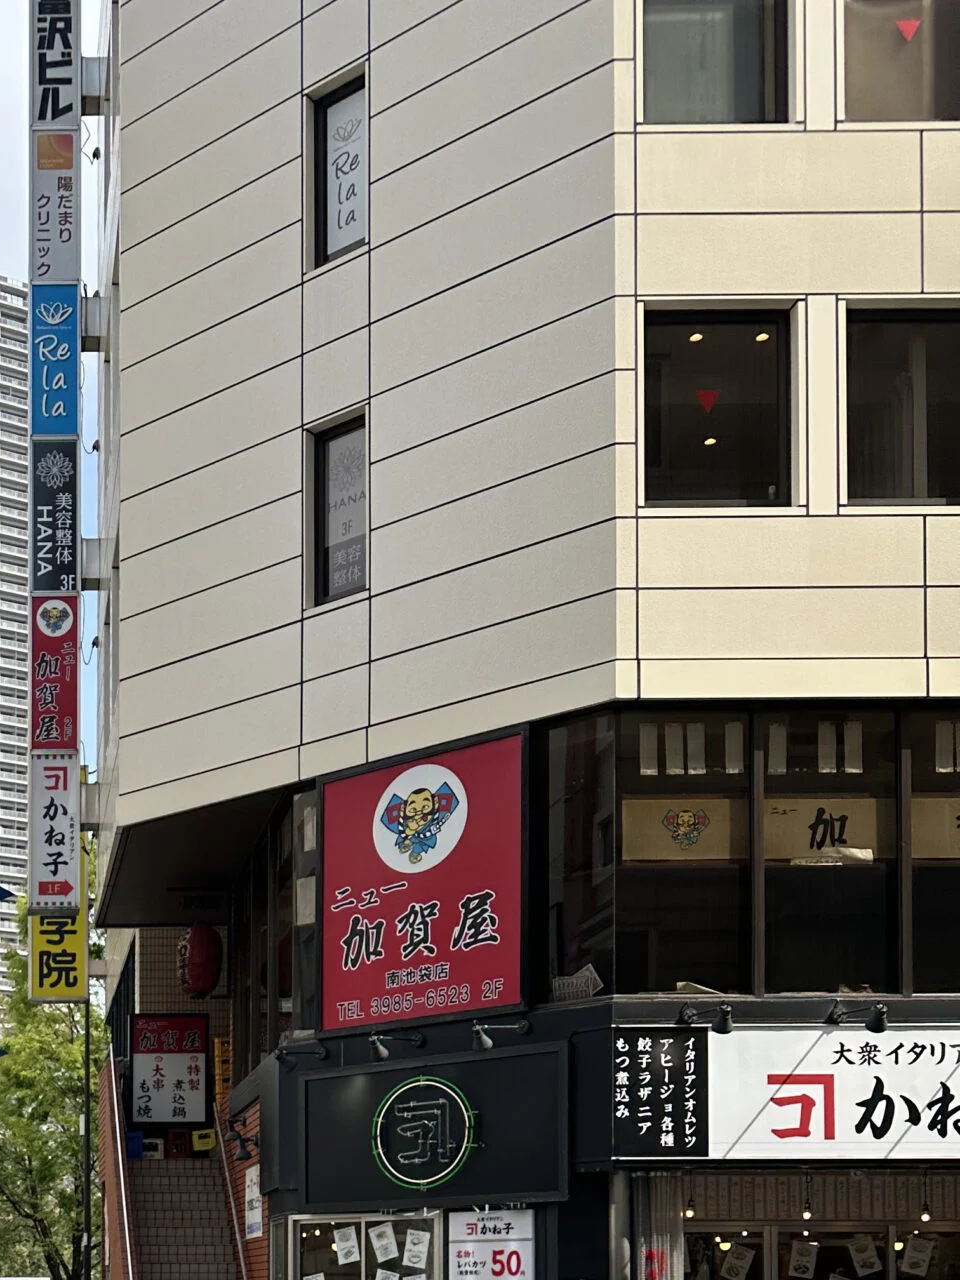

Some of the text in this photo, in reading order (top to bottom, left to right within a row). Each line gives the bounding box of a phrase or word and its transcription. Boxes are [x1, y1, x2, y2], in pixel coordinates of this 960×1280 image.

[331, 151, 360, 179] Re
[57, 176, 73, 243] 陽だまり
[36, 193, 51, 277] クリニック
[35, 334, 71, 361] Re
[328, 489, 367, 514] HANA
[37, 505, 53, 577] HANA
[55, 492, 73, 565] 美容整体
[342, 519, 353, 537] 3F
[60, 574, 76, 591] 3F
[61, 642, 76, 682] ニュー
[34, 651, 61, 742] 加賀屋
[63, 716, 73, 741] 2F
[42, 796, 69, 877] かね子
[807, 807, 848, 850] 加
[47, 881, 61, 893] 1F
[331, 881, 408, 911] ニュー
[340, 889, 500, 970] 加賀屋
[39, 915, 78, 988] 学院
[385, 962, 450, 989] 南池袋店
[337, 979, 504, 1021] TEL 3985-6523 2F
[139, 1030, 201, 1050] 加賀屋
[615, 1037, 630, 1118] もつ煮込み
[637, 1037, 652, 1135] 餃子ラザニア
[660, 1038, 675, 1147] アヒージョ各種
[683, 1037, 696, 1148] イタリアンオムレツ
[136, 1079, 152, 1119] もつ焼
[480, 1222, 514, 1235] かね子
